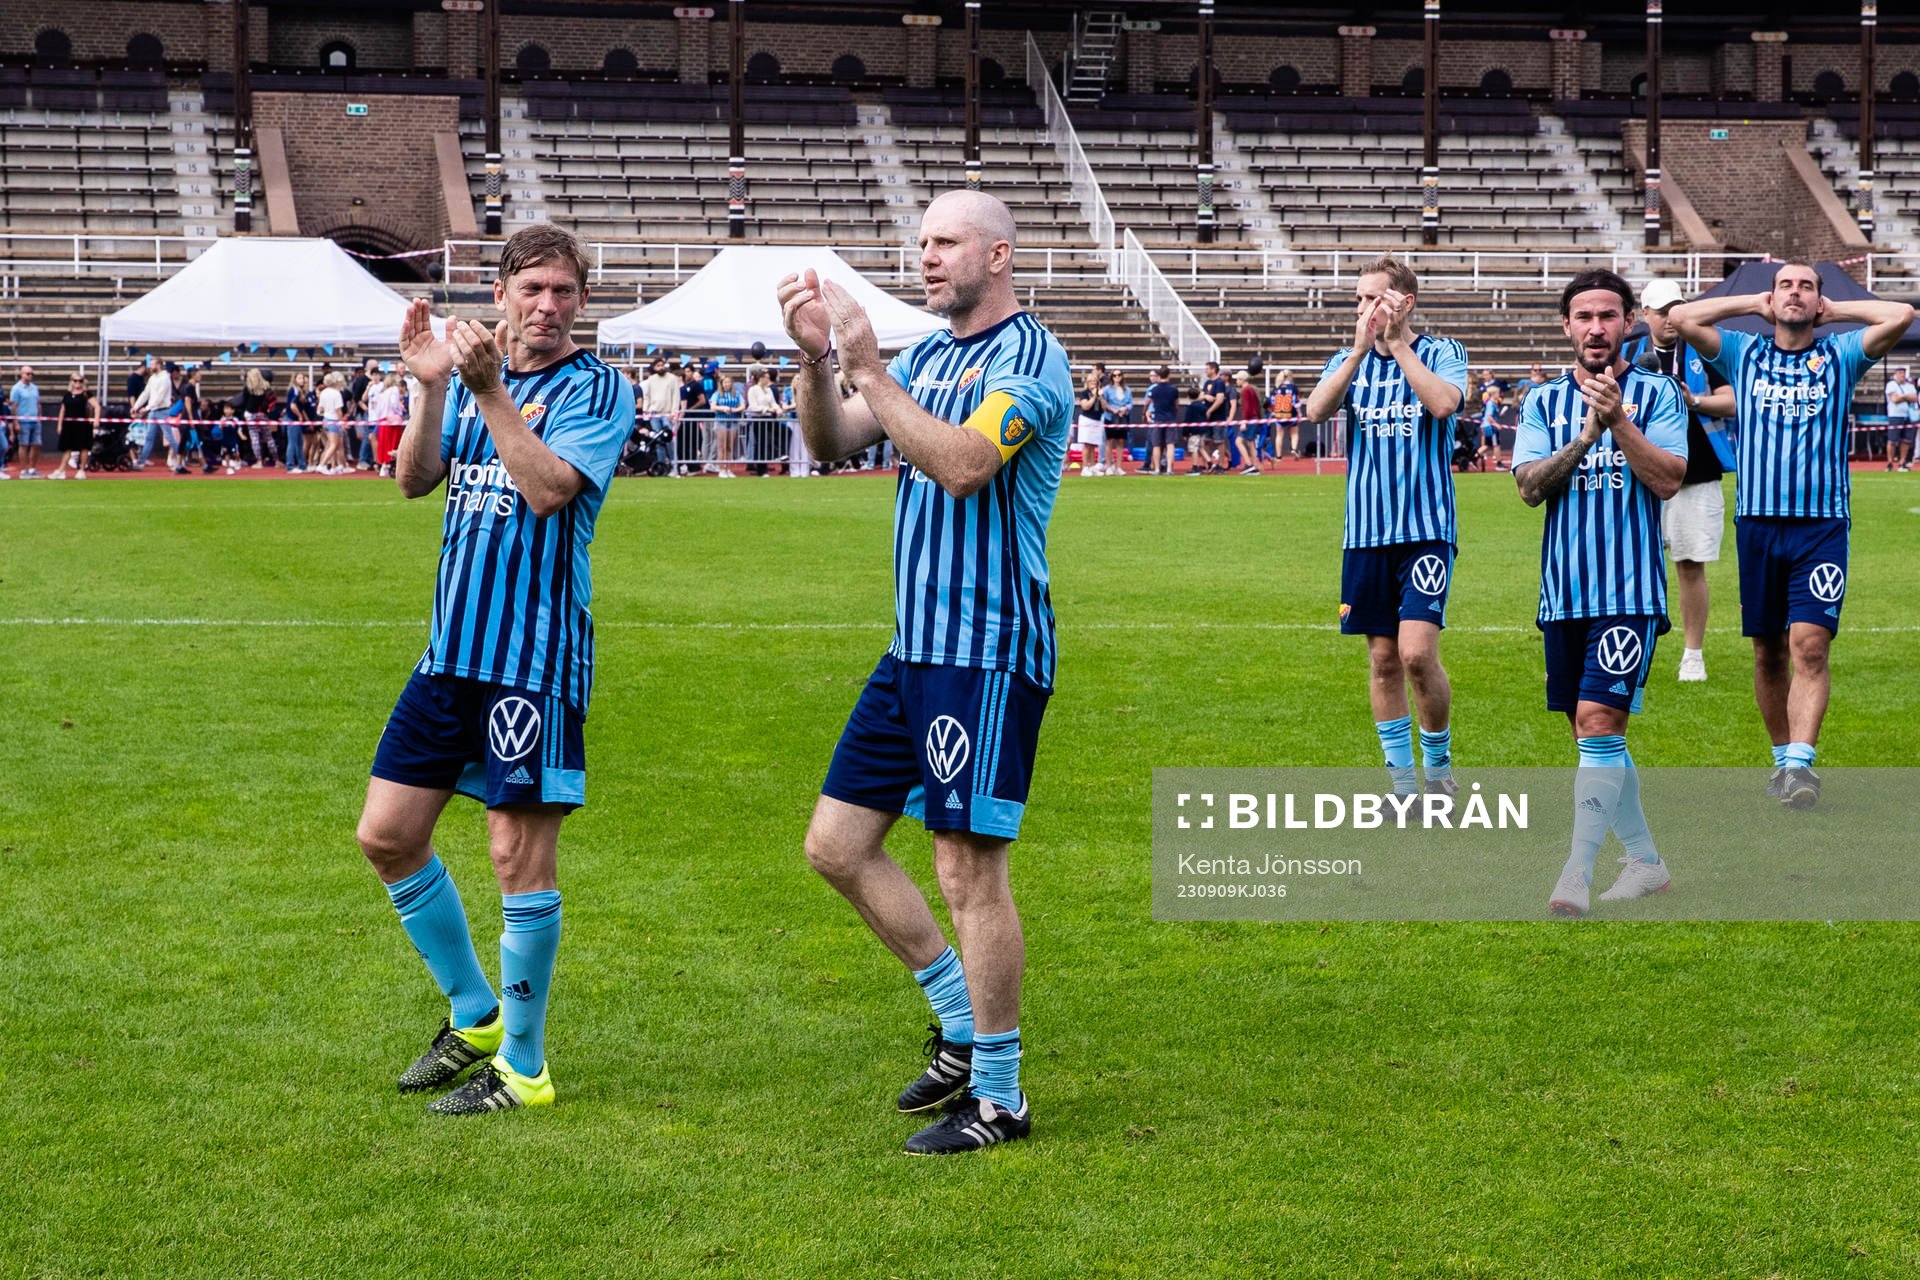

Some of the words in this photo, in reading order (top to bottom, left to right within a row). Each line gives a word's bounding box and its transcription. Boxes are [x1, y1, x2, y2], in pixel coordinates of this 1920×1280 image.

[184, 123, 192, 132] 17
[508, 130, 516, 138] 17
[874, 136, 882, 144] 17
[186, 143, 195, 152] 16
[881, 155, 889, 163] 16
[188, 164, 197, 172] 15
[517, 170, 526, 178] 15
[888, 175, 896, 183] 15
[1234, 181, 1242, 189] 15
[191, 185, 200, 194] 14
[522, 190, 531, 199] 14
[1243, 200, 1251, 208] 14
[193, 206, 202, 215] 13
[526, 211, 535, 219] 13
[902, 216, 911, 224] 13
[1254, 220, 1262, 228] 13
[196, 227, 205, 236] 12
[910, 237, 918, 245] 12
[1264, 240, 1272, 248] 12
[1276, 260, 1282, 268] 11
[1752, 379, 1828, 400] Prioritet
[1760, 397, 1818, 417] Finans
[1572, 472, 1624, 492] inans
[505, 776, 535, 785] adidas
